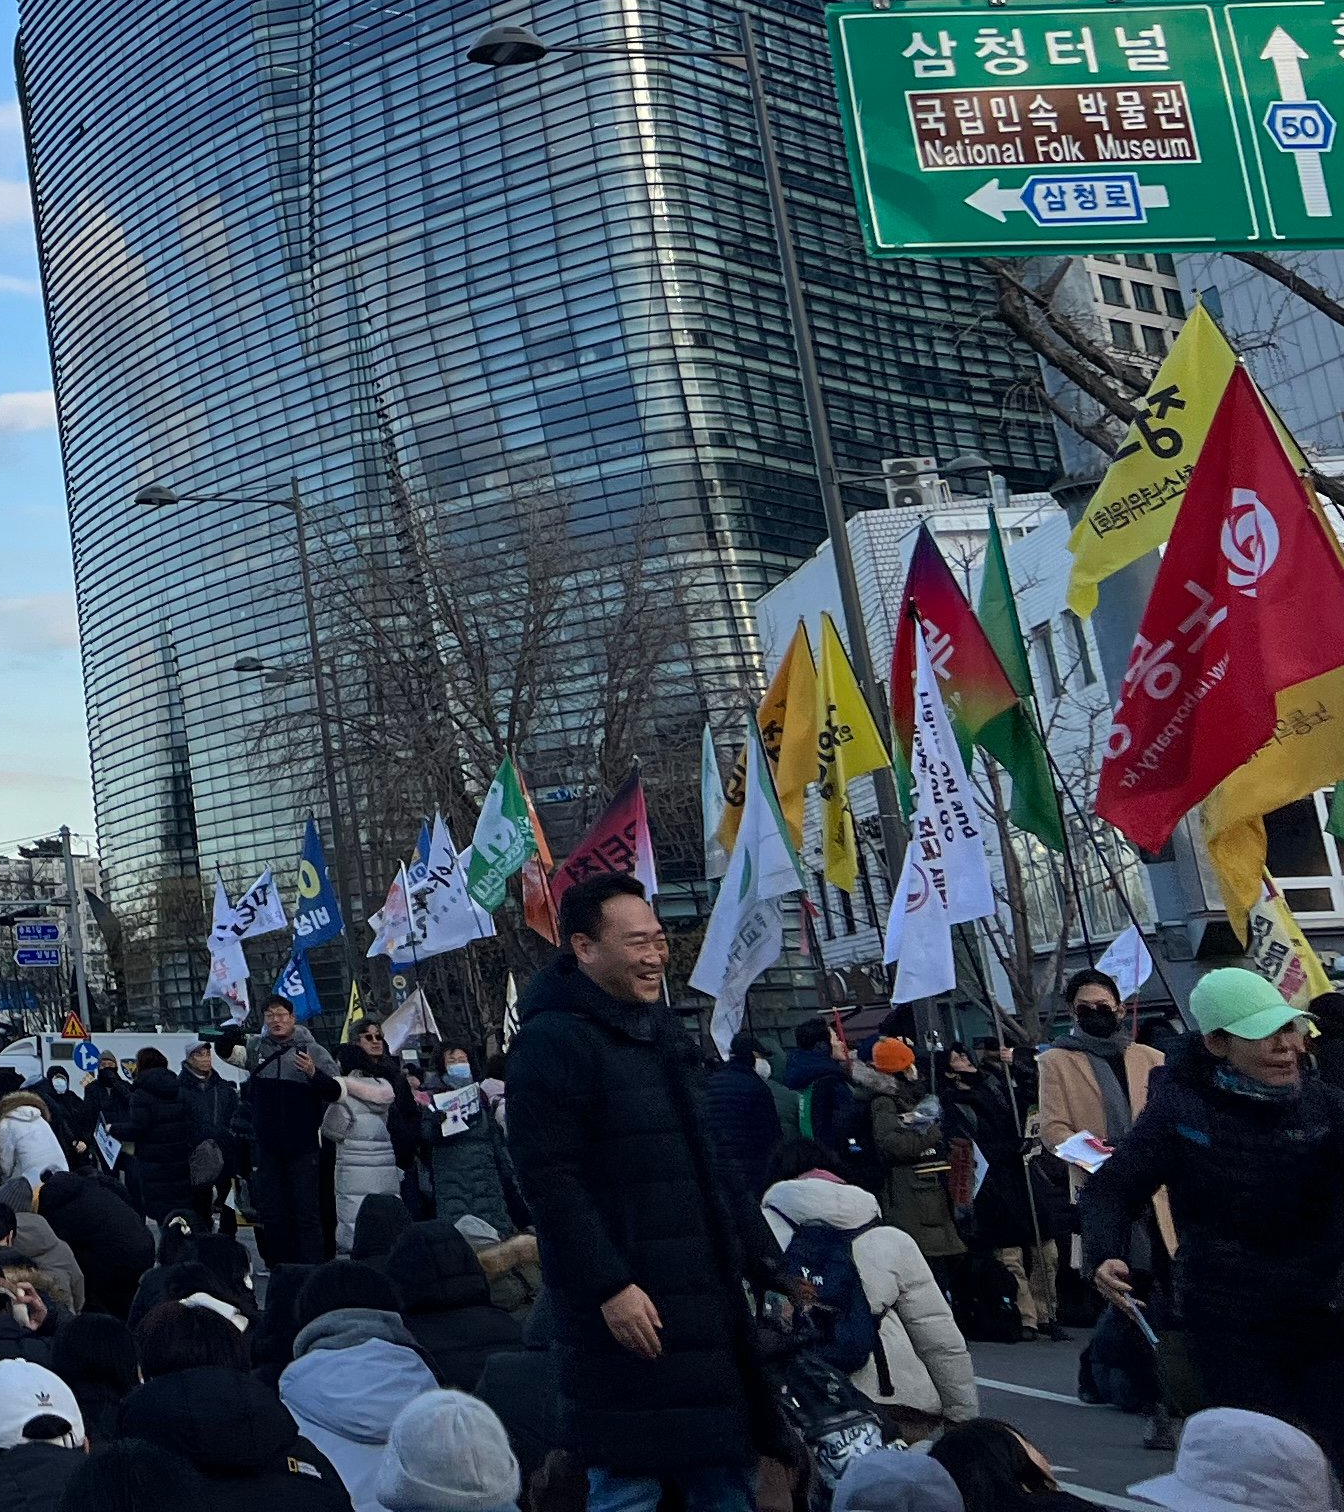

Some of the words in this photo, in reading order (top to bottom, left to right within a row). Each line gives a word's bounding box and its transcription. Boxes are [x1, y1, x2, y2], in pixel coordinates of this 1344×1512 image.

[902, 24, 1170, 78] 삼청터널
[916, 94, 1059, 137] 국립민속
[1080, 90, 1186, 131] 박물관
[1281, 116, 1320, 138] 50
[924, 141, 1025, 166] National
[1034, 135, 1082, 163] Folk
[1097, 136, 1191, 162] Museum
[1042, 183, 1132, 211] 삼청로
